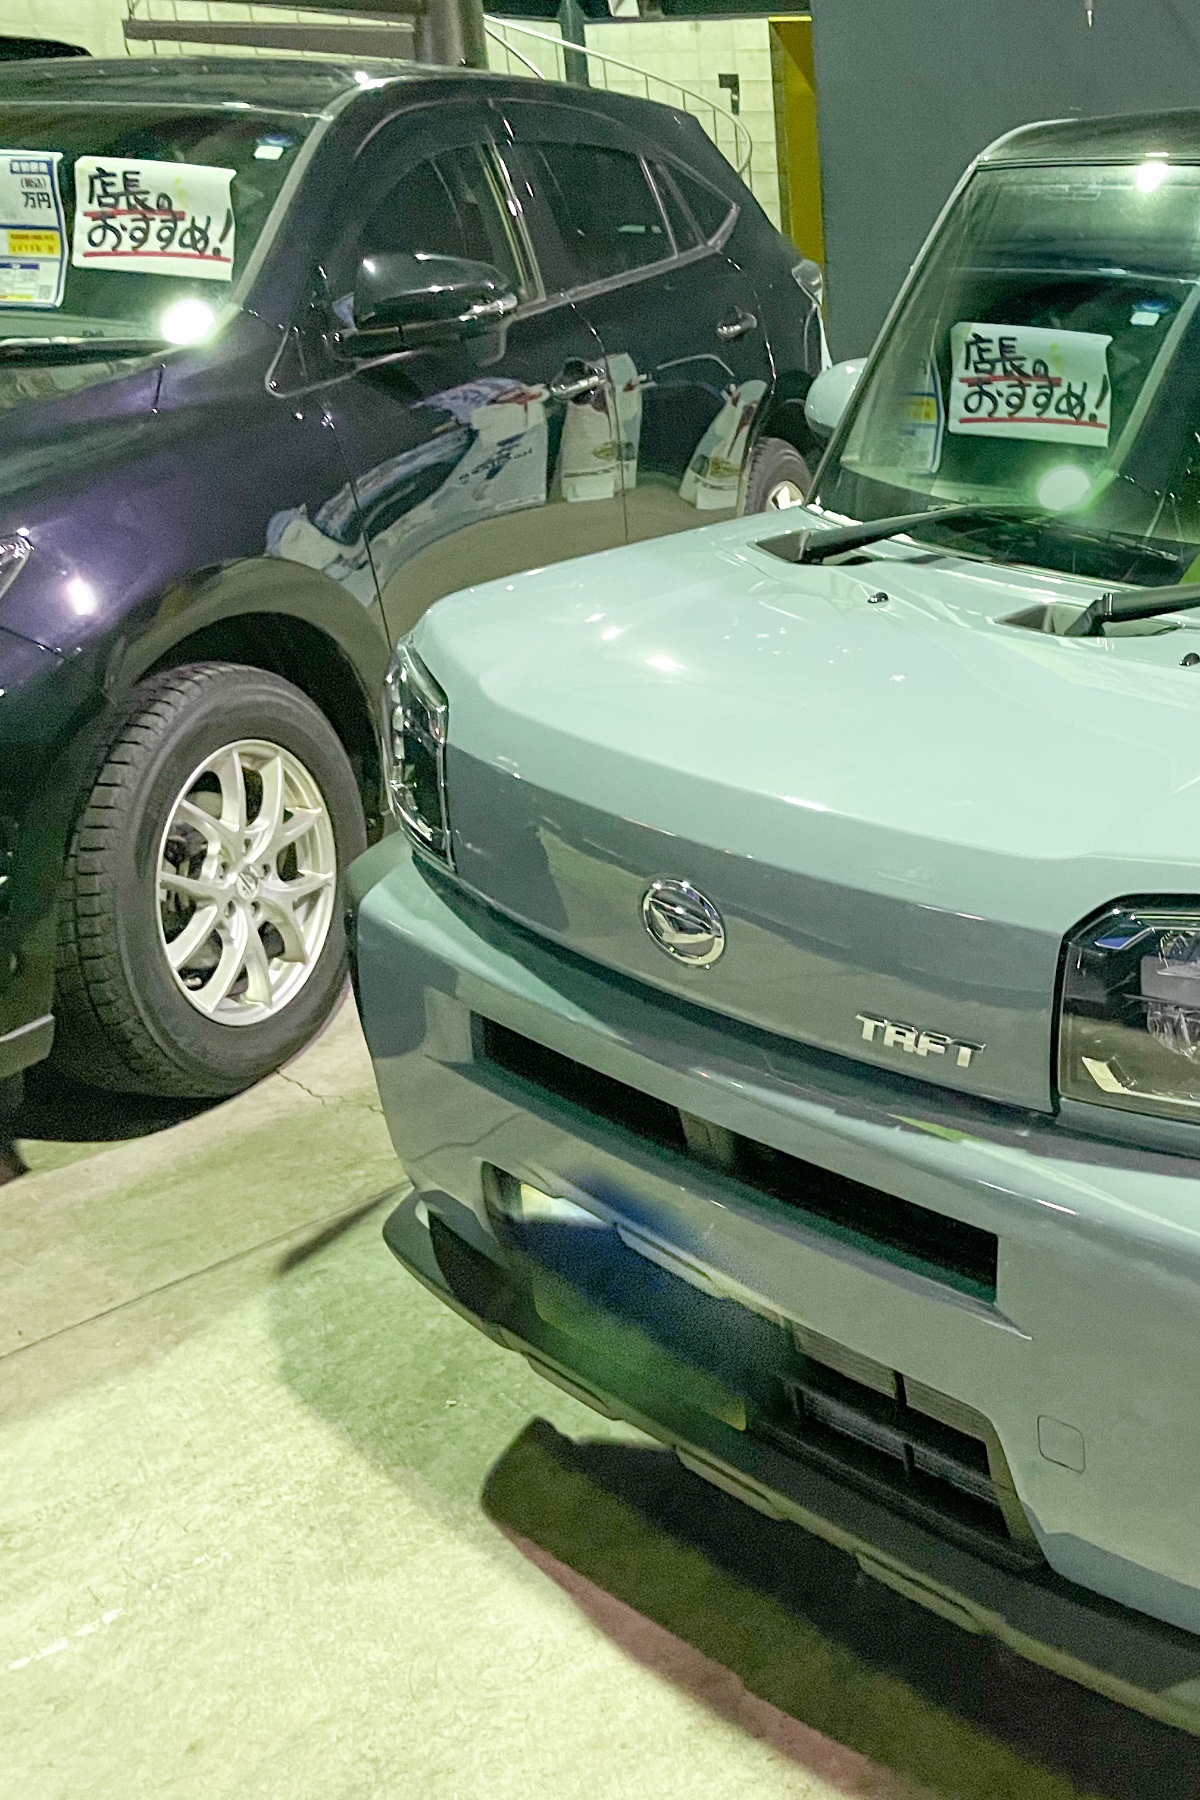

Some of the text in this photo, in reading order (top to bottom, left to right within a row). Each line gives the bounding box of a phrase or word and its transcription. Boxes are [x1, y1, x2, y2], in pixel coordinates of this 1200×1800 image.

[21, 191, 51, 209] 万円
[88, 167, 174, 212] 店長の
[965, 333, 1049, 378] 店長の
[855, 1011, 986, 1068] TAFT
